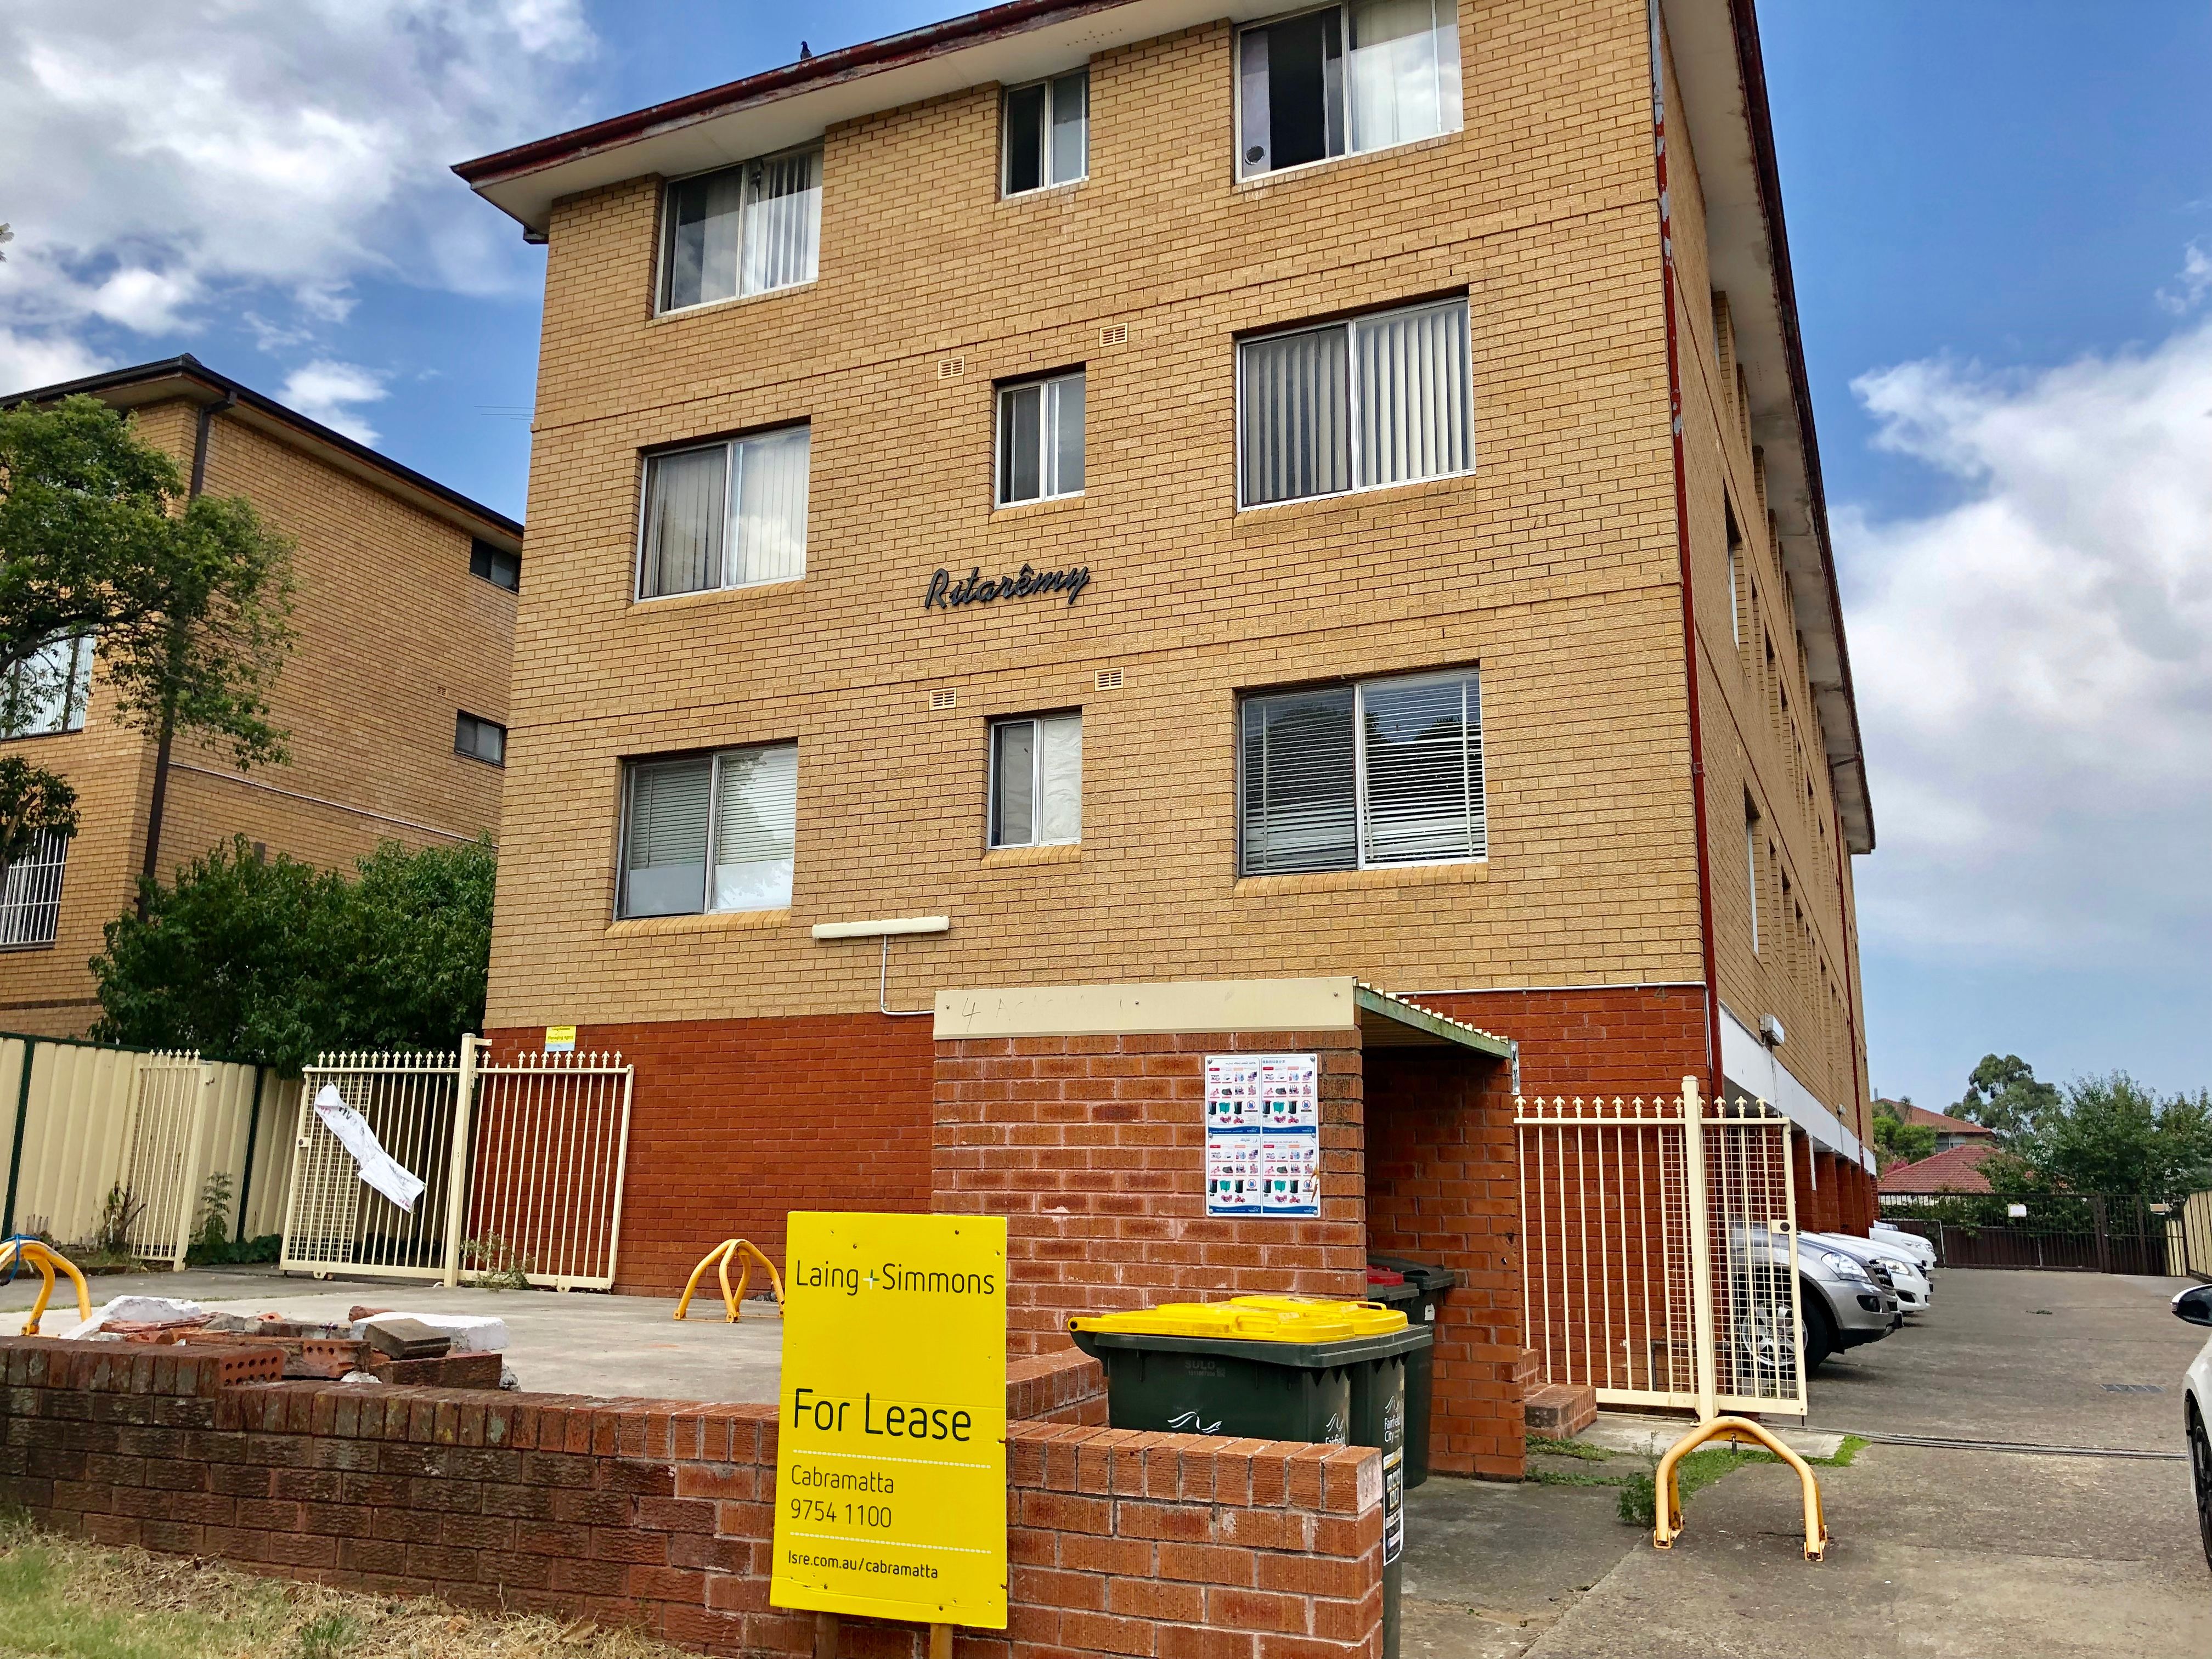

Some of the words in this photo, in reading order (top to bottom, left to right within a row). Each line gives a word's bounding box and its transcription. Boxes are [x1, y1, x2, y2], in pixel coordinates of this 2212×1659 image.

[924, 563, 1091, 609] Ritarêmy
[1654, 986, 1668, 1002] 4
[962, 997, 981, 1032] 4
[794, 1387, 850, 1432] For
[865, 1392, 971, 1441] Lease
[1384, 1414, 1401, 1430] Fairfield
[1384, 1430, 1394, 1443] City
[791, 1464, 894, 1493] Cabramatta
[791, 1498, 837, 1523] 9754
[845, 1503, 891, 1528] 1100
[788, 1549, 938, 1579] lsre.com.au/cabramatta
